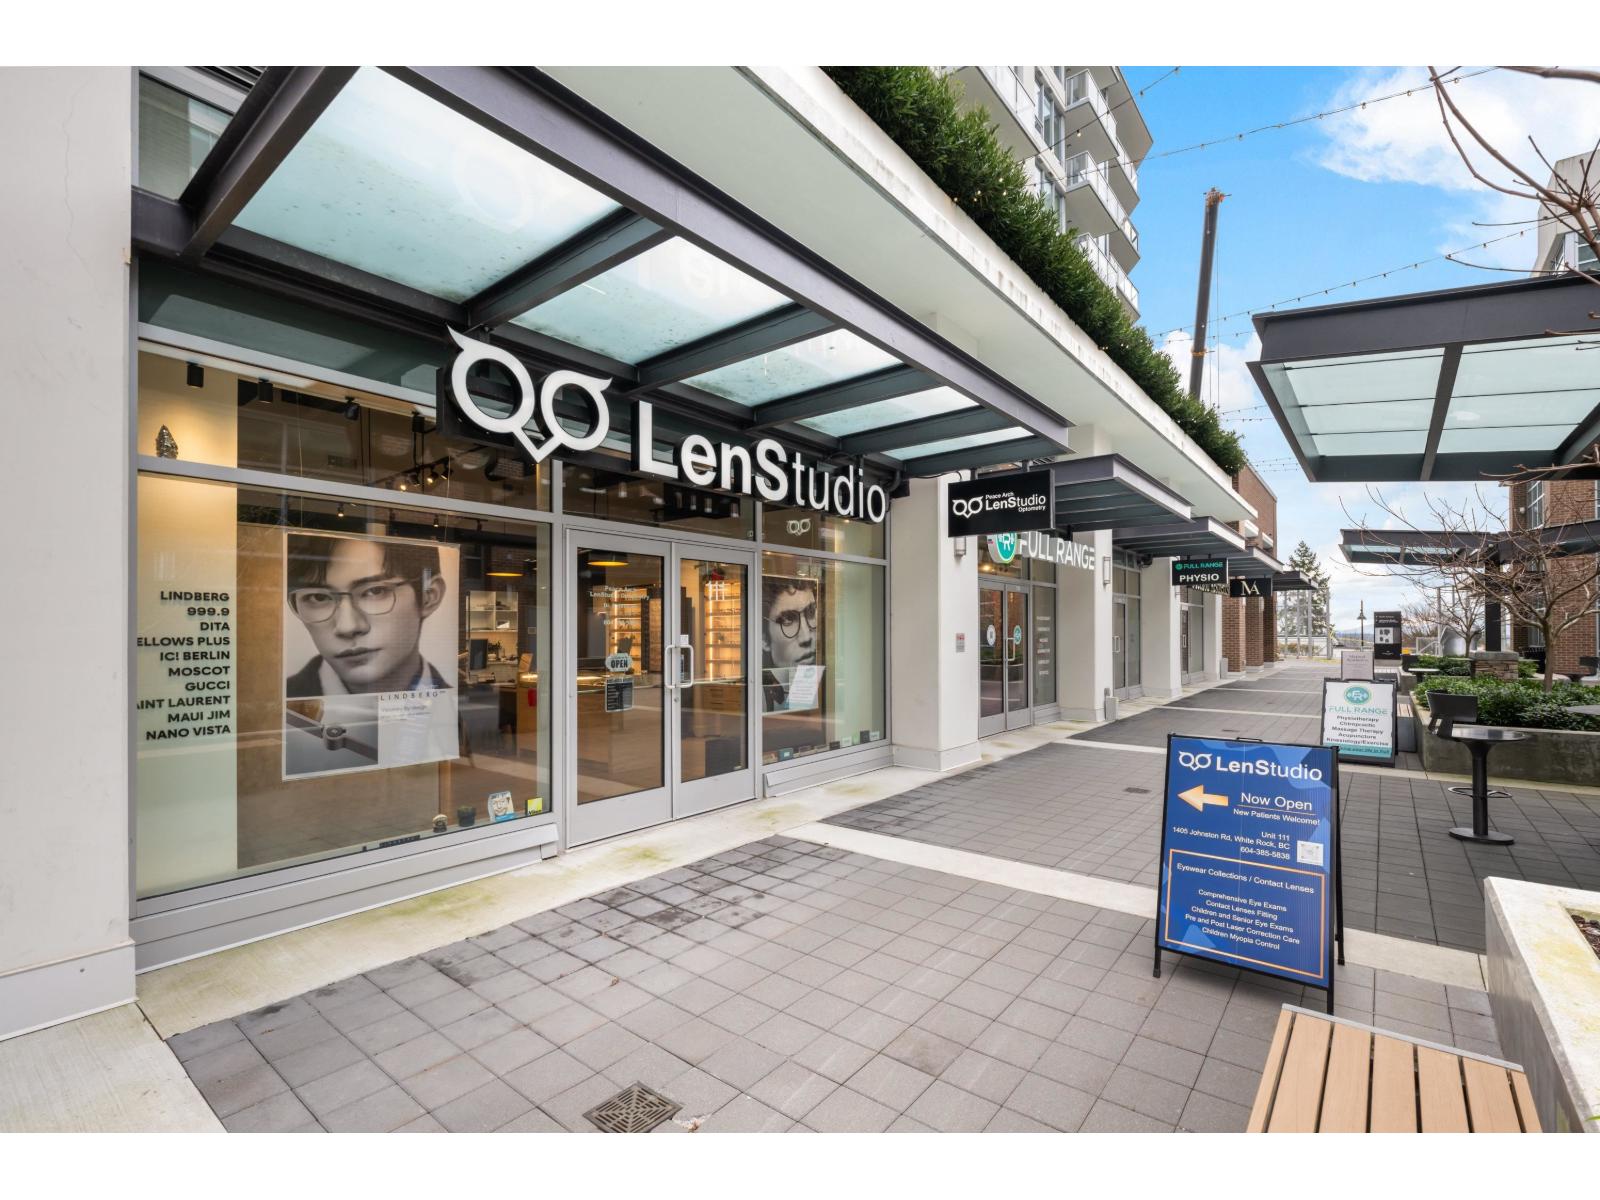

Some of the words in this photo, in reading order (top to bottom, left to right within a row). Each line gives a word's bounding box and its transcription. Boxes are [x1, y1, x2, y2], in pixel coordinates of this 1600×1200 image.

[638, 399, 886, 523] LenStudio
[986, 494, 1046, 511] LenStudio
[1018, 530, 1053, 561] FULL
[1056, 538, 1095, 570] RANGE
[1180, 573, 1220, 582] PHYSIO
[160, 591, 230, 601] LINDBERG
[187, 607, 230, 616] 999.9
[200, 622, 230, 631] DITA
[137, 637, 194, 647] ELLOWS
[198, 636, 230, 646] PLUS
[160, 652, 179, 661] IC!
[183, 651, 230, 661] BERLIN
[168, 666, 231, 677] MOSCOT
[611, 660, 628, 669] OPEN
[185, 681, 230, 691] GUCCI
[137, 699, 164, 710] INT
[168, 696, 231, 708] LAURENT
[381, 692, 438, 701] LINDBERG
[168, 712, 203, 723] MAUI
[207, 710, 231, 720] JIM
[1328, 705, 1352, 713] FULL
[1354, 707, 1388, 715] RANGE
[146, 728, 189, 740] NANO
[193, 725, 231, 736] VISTA
[1216, 756, 1322, 781] LenStudio
[1241, 792, 1270, 805] Now
[1274, 796, 1313, 811] Open
[1234, 808, 1250, 817] New
[1251, 810, 1281, 820] Patients
[1282, 814, 1320, 826] Welcome!
[1172, 826, 1188, 834] 1405
[1189, 829, 1219, 839] Johnston
[1234, 836, 1254, 845] White
[1256, 839, 1276, 849] Rock,
[1278, 842, 1290, 850] BC
[1262, 832, 1276, 840] Unit
[1177, 863, 1207, 874] Eyewear
[1208, 868, 1248, 882] Collections
[1254, 876, 1284, 888] Contact
[1285, 882, 1315, 894] Lenses
[1198, 889, 1247, 904] Comprehensive
[1249, 899, 1262, 907] Eye
[1264, 902, 1287, 912] Exams
[1206, 900, 1230, 910] Contact
[1232, 905, 1255, 915] Lenses
[1257, 910, 1278, 921] Fitting
[1192, 906, 1217, 917] Children
[1232, 914, 1253, 924] Senior
[1255, 919, 1268, 928] Eye
[1270, 922, 1294, 933] Exams
[1185, 914, 1196, 922] Pre
[1198, 916, 1210, 924] and
[1211, 918, 1225, 928] Post
[1226, 923, 1245, 932] Laser
[1246, 927, 1281, 941] Correction
[1283, 936, 1300, 945] Care
[1202, 927, 1229, 938] Children
[1230, 933, 1254, 944] Myopia
[1255, 939, 1280, 950] Control
